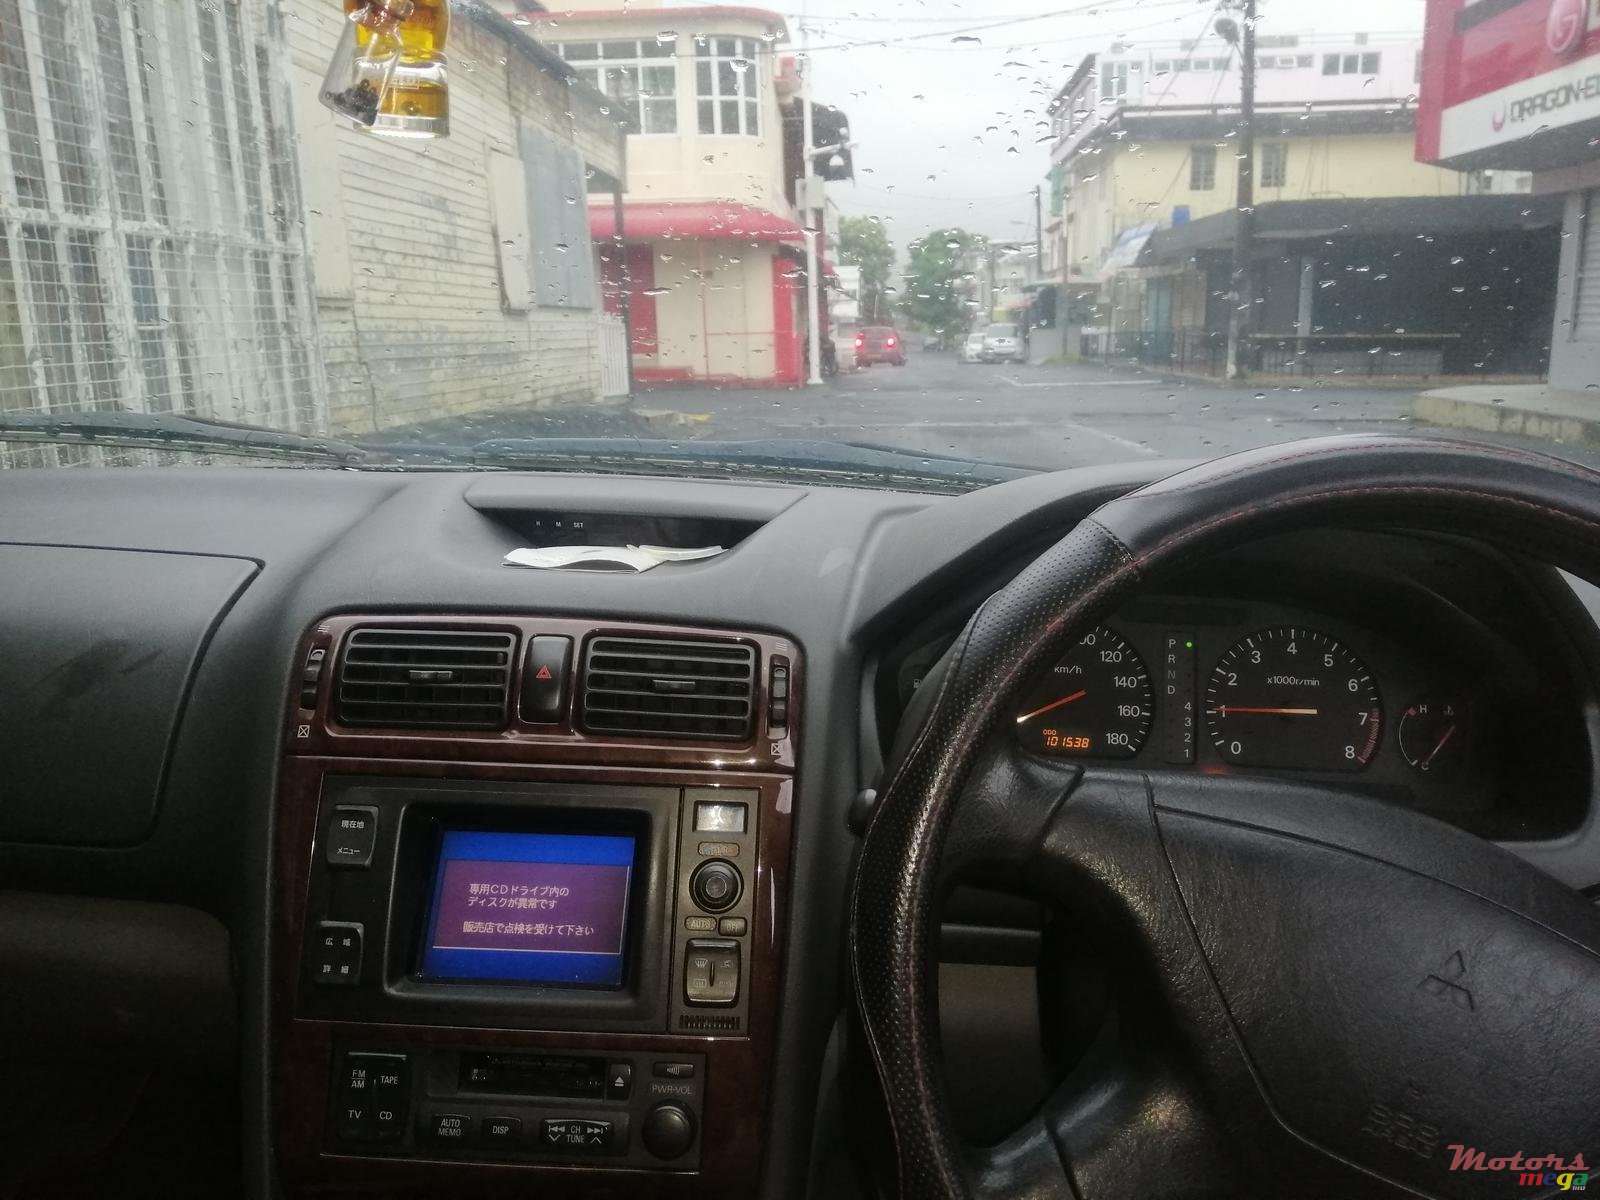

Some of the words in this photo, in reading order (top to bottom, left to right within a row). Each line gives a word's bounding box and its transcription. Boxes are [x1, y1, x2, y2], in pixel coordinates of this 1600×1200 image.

[1168, 638, 1177, 649] P
[1286, 642, 1298, 655] 4
[1100, 650, 1122, 663] 120
[1167, 654, 1176, 665] R
[1251, 650, 1261, 664] 3
[1324, 654, 1334, 667] 5
[1054, 665, 1082, 675] km/h
[1167, 670, 1176, 680] N
[1114, 676, 1137, 688] 140
[1227, 672, 1238, 686] 2
[1167, 685, 1176, 695] D
[1348, 679, 1358, 692] 6
[1117, 705, 1140, 717] 160
[1183, 701, 1192, 712] 4
[1419, 704, 1428, 714] H
[1183, 717, 1192, 728] 3
[1358, 712, 1368, 726] 7
[1045, 736, 1090, 748] 101538
[1105, 733, 1128, 746] 180
[1183, 732, 1192, 743] 2
[1230, 741, 1242, 755] 0
[1344, 745, 1356, 759] 8
[341, 819, 365, 829] 現在地
[337, 847, 360, 855] メニュー
[469, 883, 570, 897] 専用CDドライブ内の
[468, 896, 557, 910] ディスクが異常です
[463, 921, 594, 936] 販売店で点検を受けて下さい
[352, 1069, 366, 1078] FM
[351, 1079, 365, 1088] AM
[381, 1075, 398, 1085] TAPE
[348, 1109, 362, 1119] TV
[379, 1111, 393, 1120] CD
[441, 1119, 460, 1128] AUTO
[438, 1127, 462, 1137] MEMO
[492, 1125, 509, 1135] DISP
[570, 1125, 581, 1134] CH
[567, 1134, 584, 1143] TUNE
